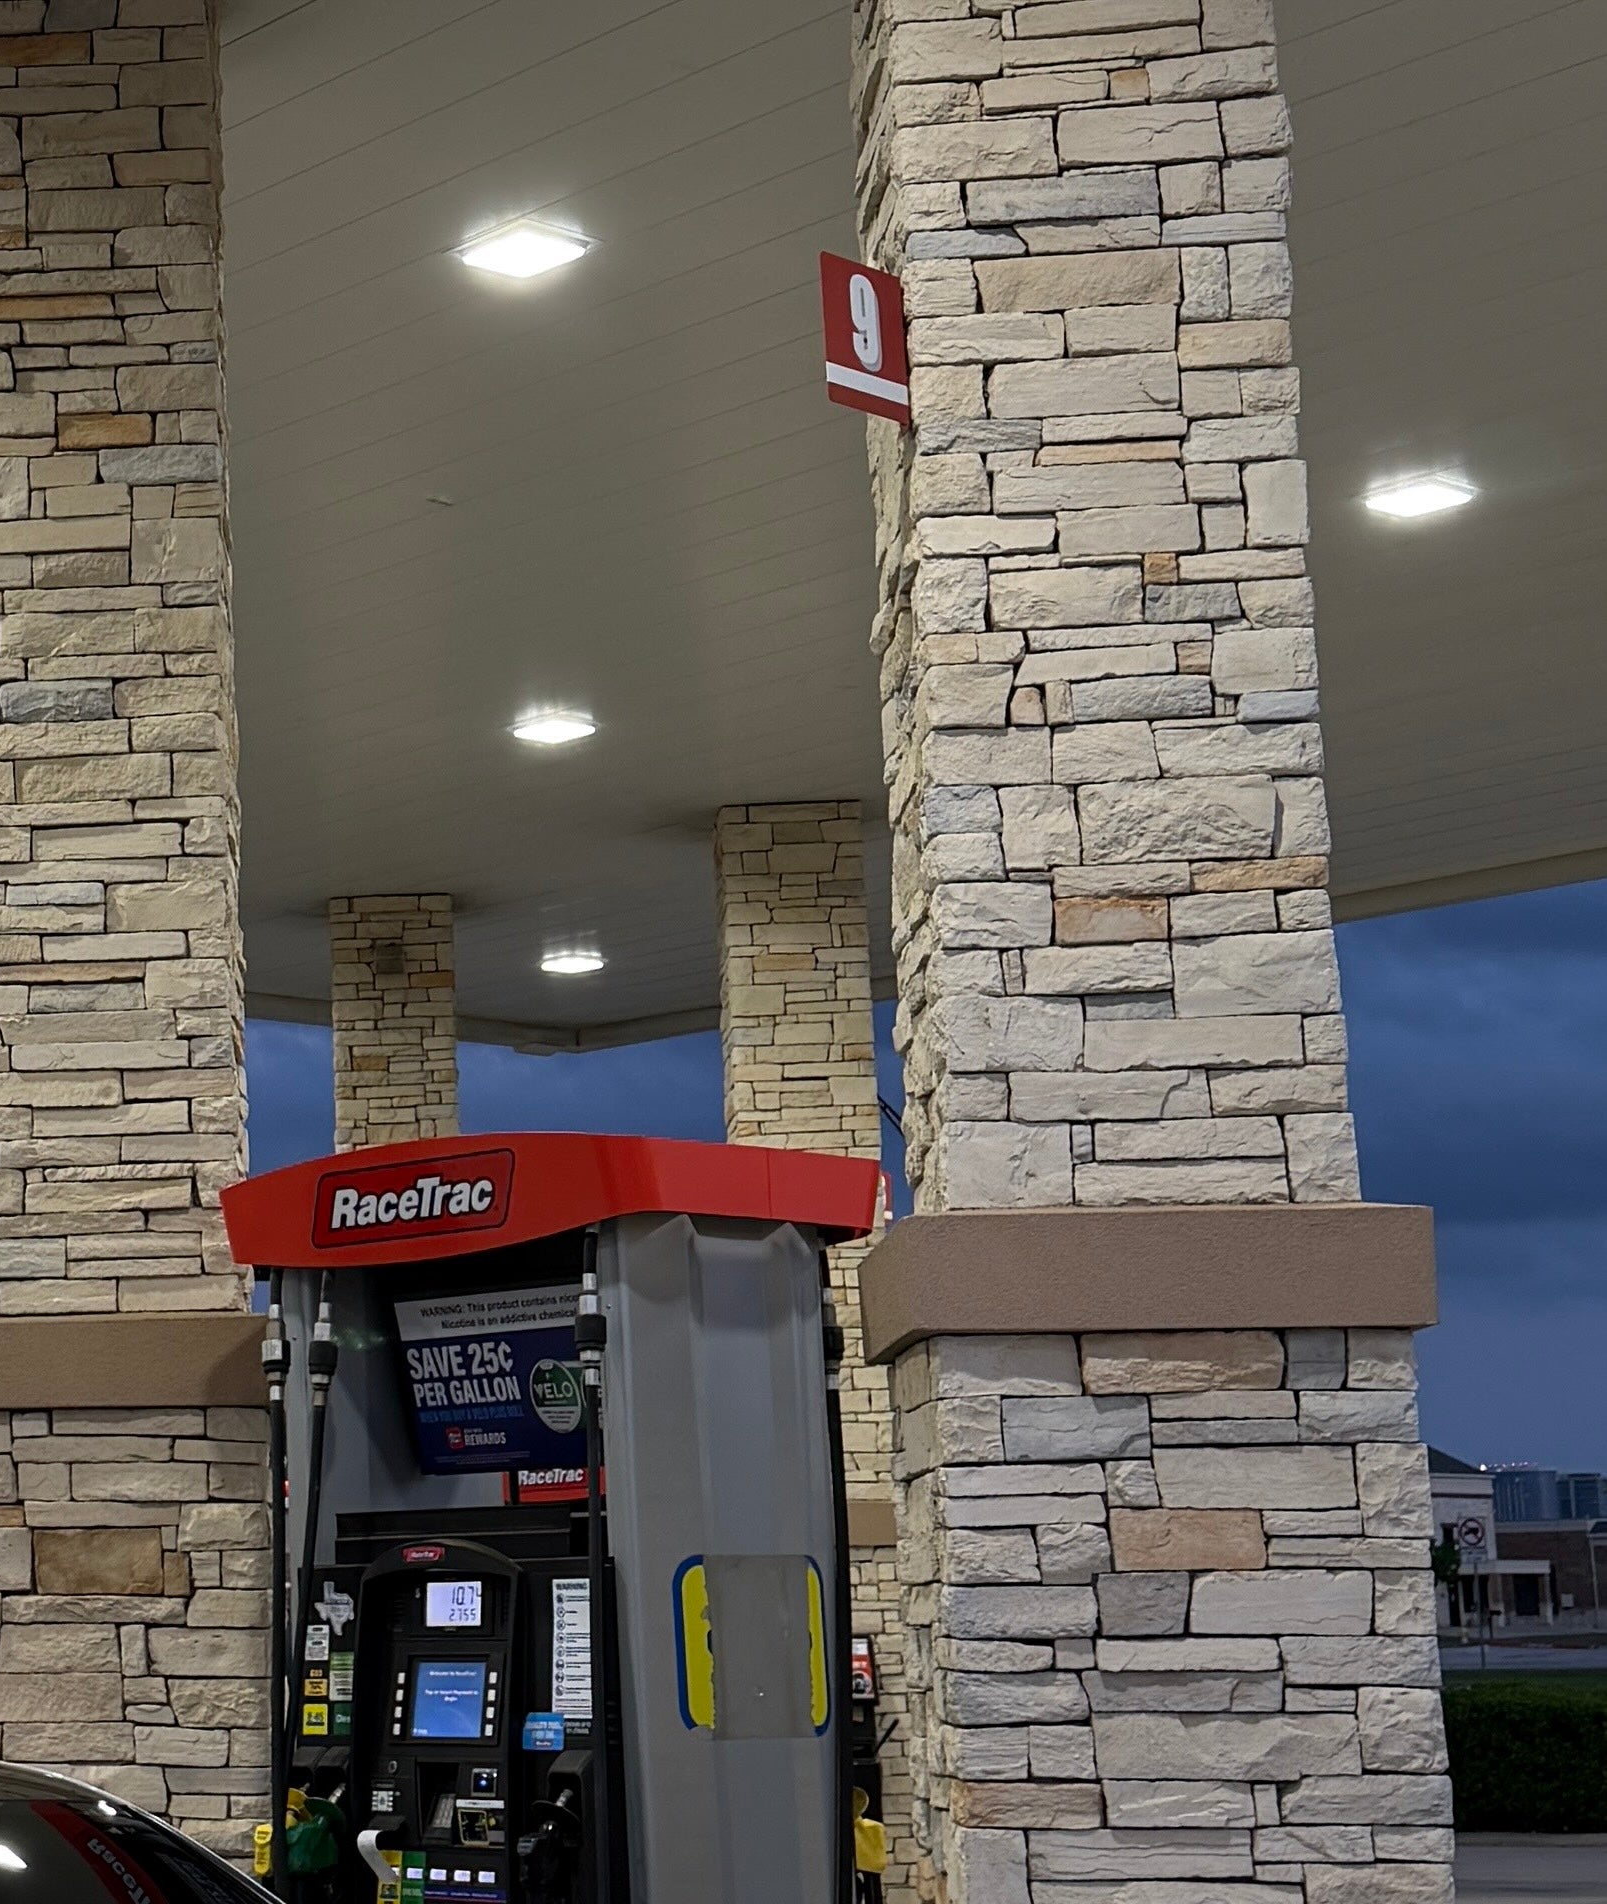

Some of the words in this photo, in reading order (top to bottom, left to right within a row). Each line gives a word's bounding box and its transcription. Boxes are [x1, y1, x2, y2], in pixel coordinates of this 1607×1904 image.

[849, 273, 883, 373] 9
[330, 1175, 494, 1230] RaceTrac
[467, 1302, 486, 1313] This
[487, 1299, 520, 1312] product
[521, 1296, 557, 1309] contains
[441, 1319, 476, 1330] Nicotine
[499, 1310, 537, 1325] addictive
[406, 1345, 467, 1380] SAVE
[467, 1341, 514, 1375] 25¢
[412, 1382, 449, 1408] PER
[450, 1375, 522, 1405] GALLON
[533, 1381, 575, 1400] VELO
[464, 1431, 507, 1446] REWARDS
[517, 1467, 585, 1486] RaceTrac
